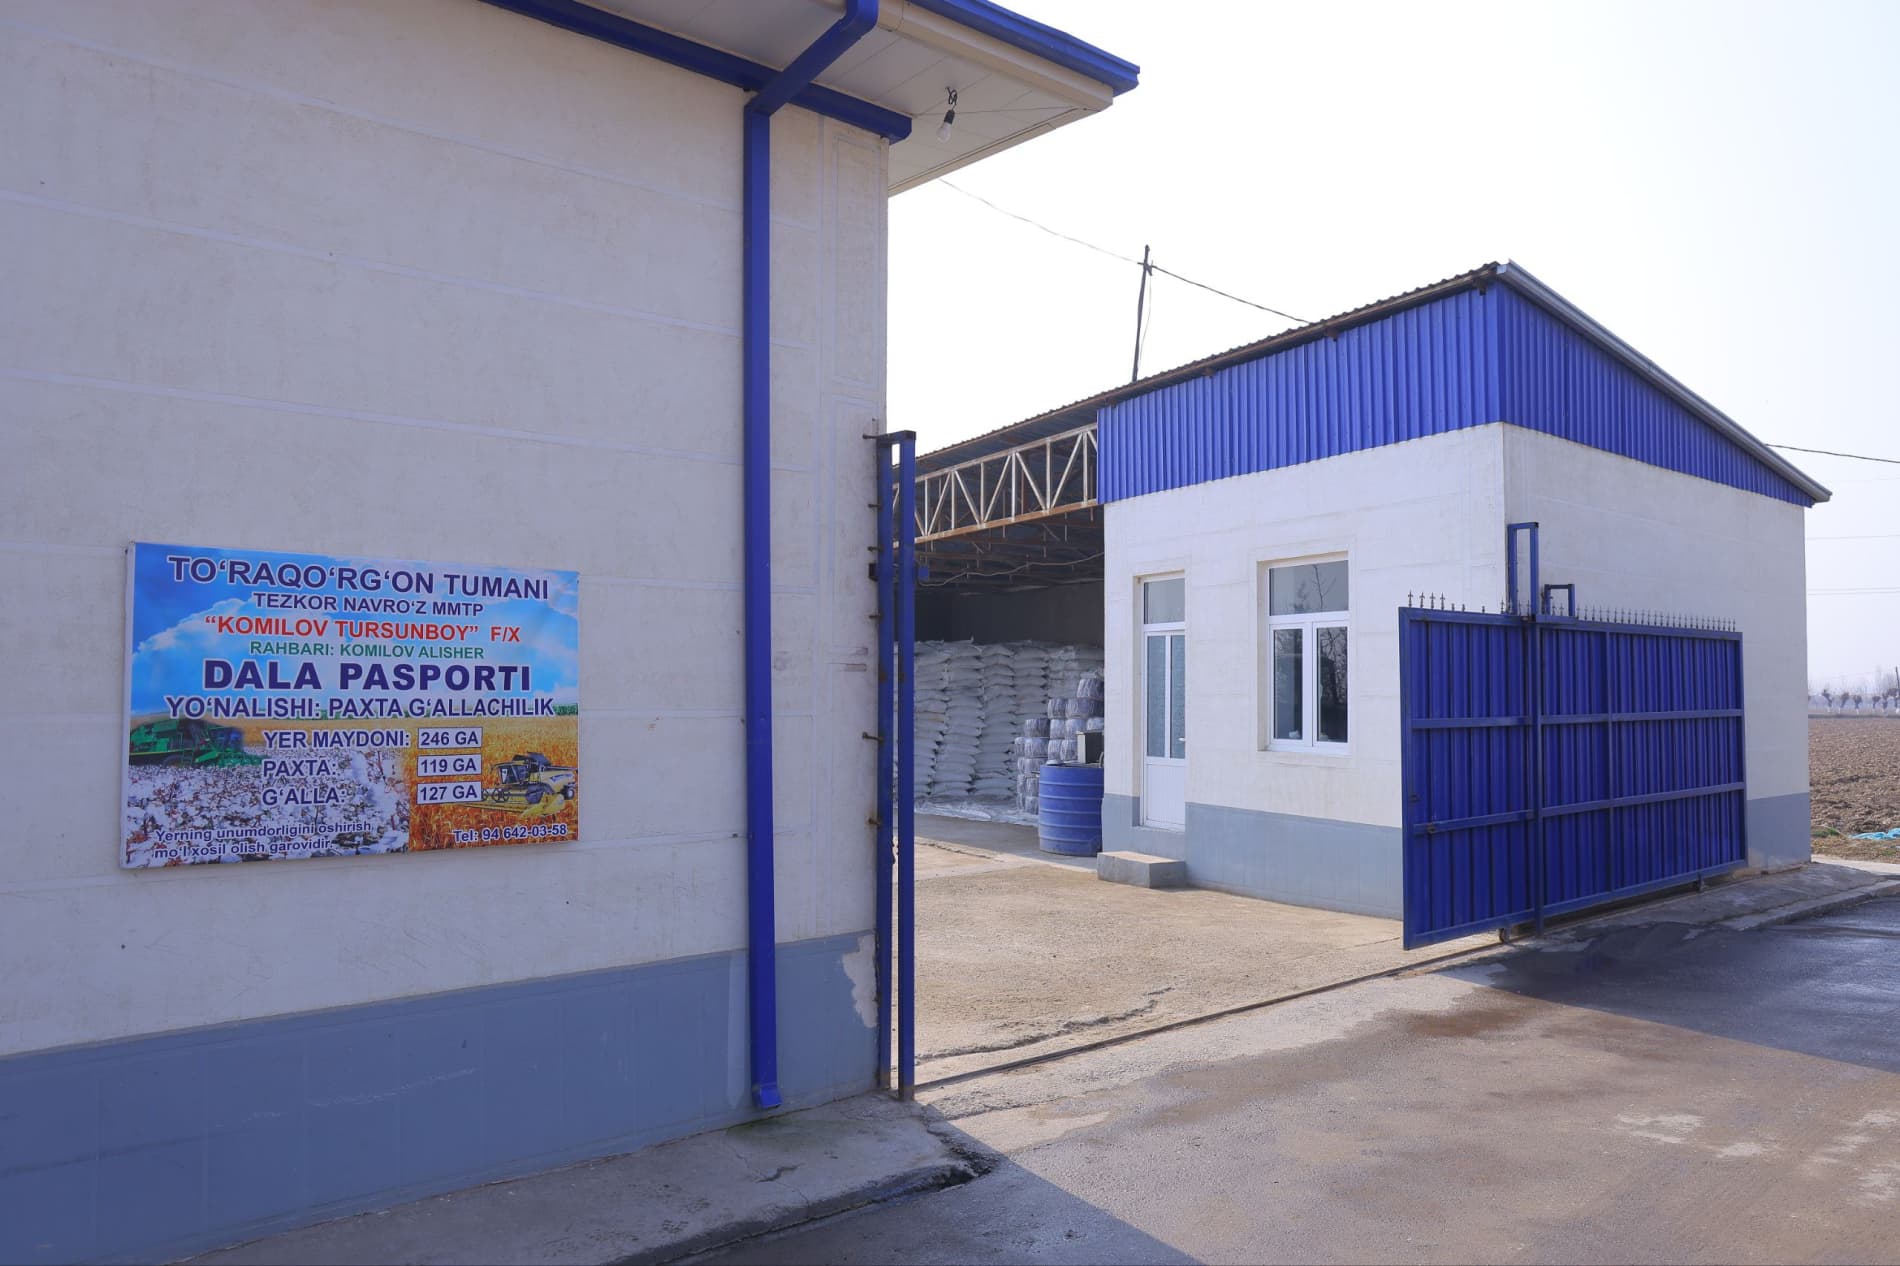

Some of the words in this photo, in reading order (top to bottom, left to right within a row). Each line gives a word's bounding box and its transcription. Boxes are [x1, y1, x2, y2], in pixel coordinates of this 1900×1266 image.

[444, 574, 548, 600] TUMANI
[253, 592, 337, 611] TEZKOR
[344, 597, 426, 615] NAVRO‘Z
[432, 601, 484, 617] MMTP
[205, 615, 328, 637] “KOMILOV
[335, 620, 479, 641] TURSUNBOY”
[491, 626, 521, 642] F/X
[251, 641, 334, 656] RAHBARI:
[340, 644, 414, 658] KOMILOV
[418, 647, 484, 659] ALISHER
[204, 659, 322, 690] DALA
[340, 663, 529, 691] PASPORTI
[166, 696, 320, 717] YO‘NALISHI:
[329, 698, 403, 717] PAXTA
[264, 732, 306, 748] YER
[313, 731, 410, 748] MAYDONI:
[421, 732, 449, 746] 246
[455, 731, 479, 745] GA
[263, 760, 337, 777] PAXTA:
[421, 759, 448, 773] 119
[453, 758, 477, 772] GA
[420, 787, 447, 801] 127
[453, 785, 478, 799] GA
[156, 829, 211, 842] Yerning
[217, 824, 314, 839] unumdorligini
[454, 828, 479, 842] Tel:
[482, 828, 499, 841] 94
[504, 824, 567, 839] 642-03-58
[192, 843, 226, 857] xosil
[231, 841, 265, 855] olish
